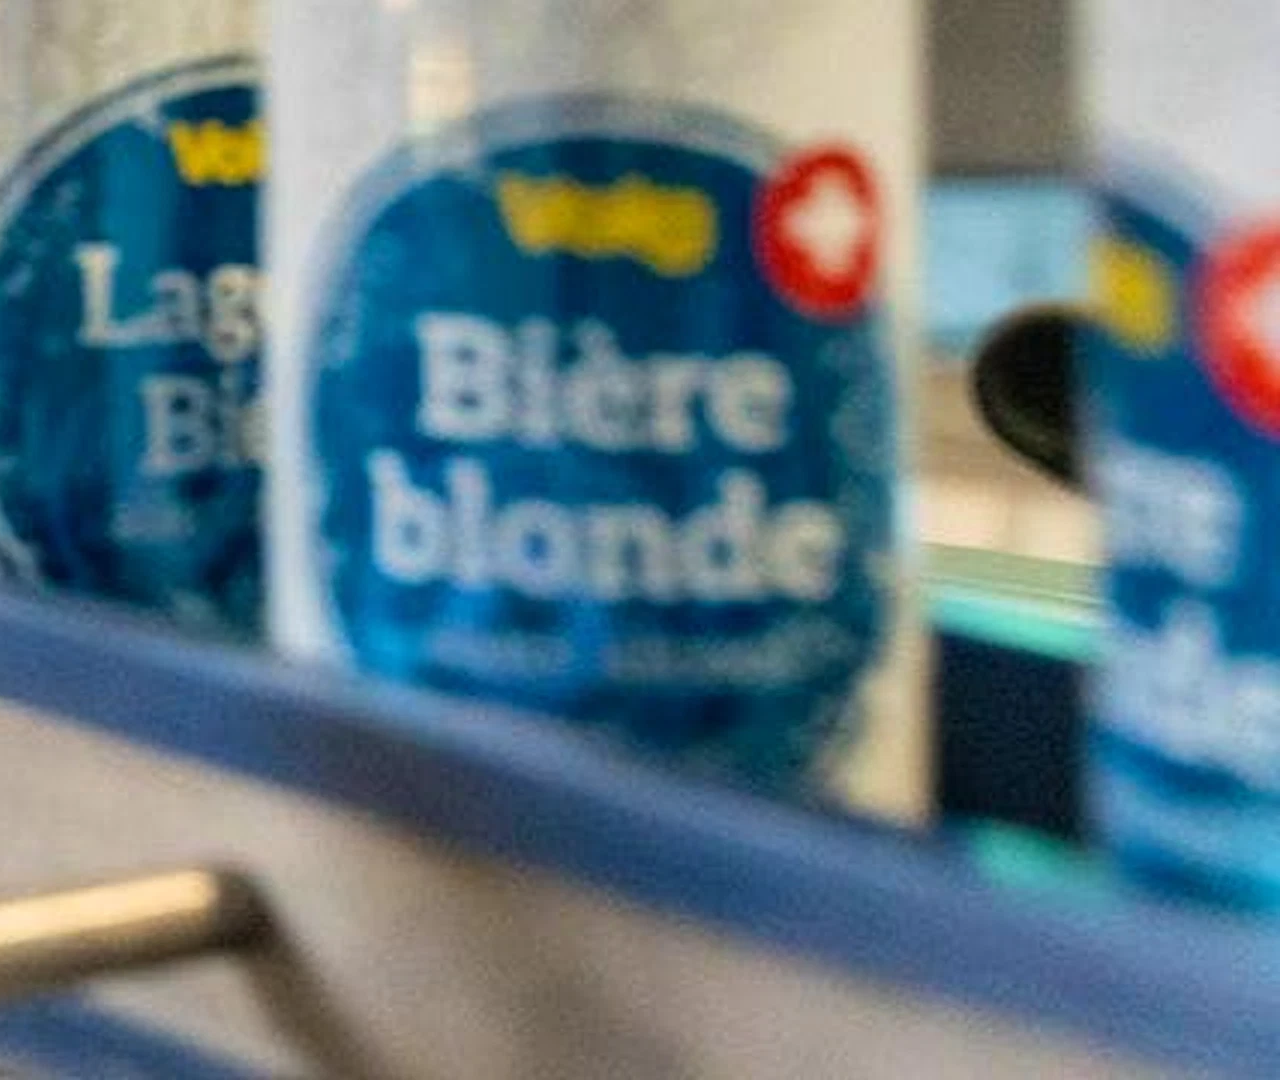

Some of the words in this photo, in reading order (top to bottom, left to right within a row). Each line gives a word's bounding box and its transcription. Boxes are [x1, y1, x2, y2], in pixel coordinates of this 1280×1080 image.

[74, 242, 270, 362] Lag
[415, 311, 795, 453] Bière
[367, 446, 843, 601] blonde
